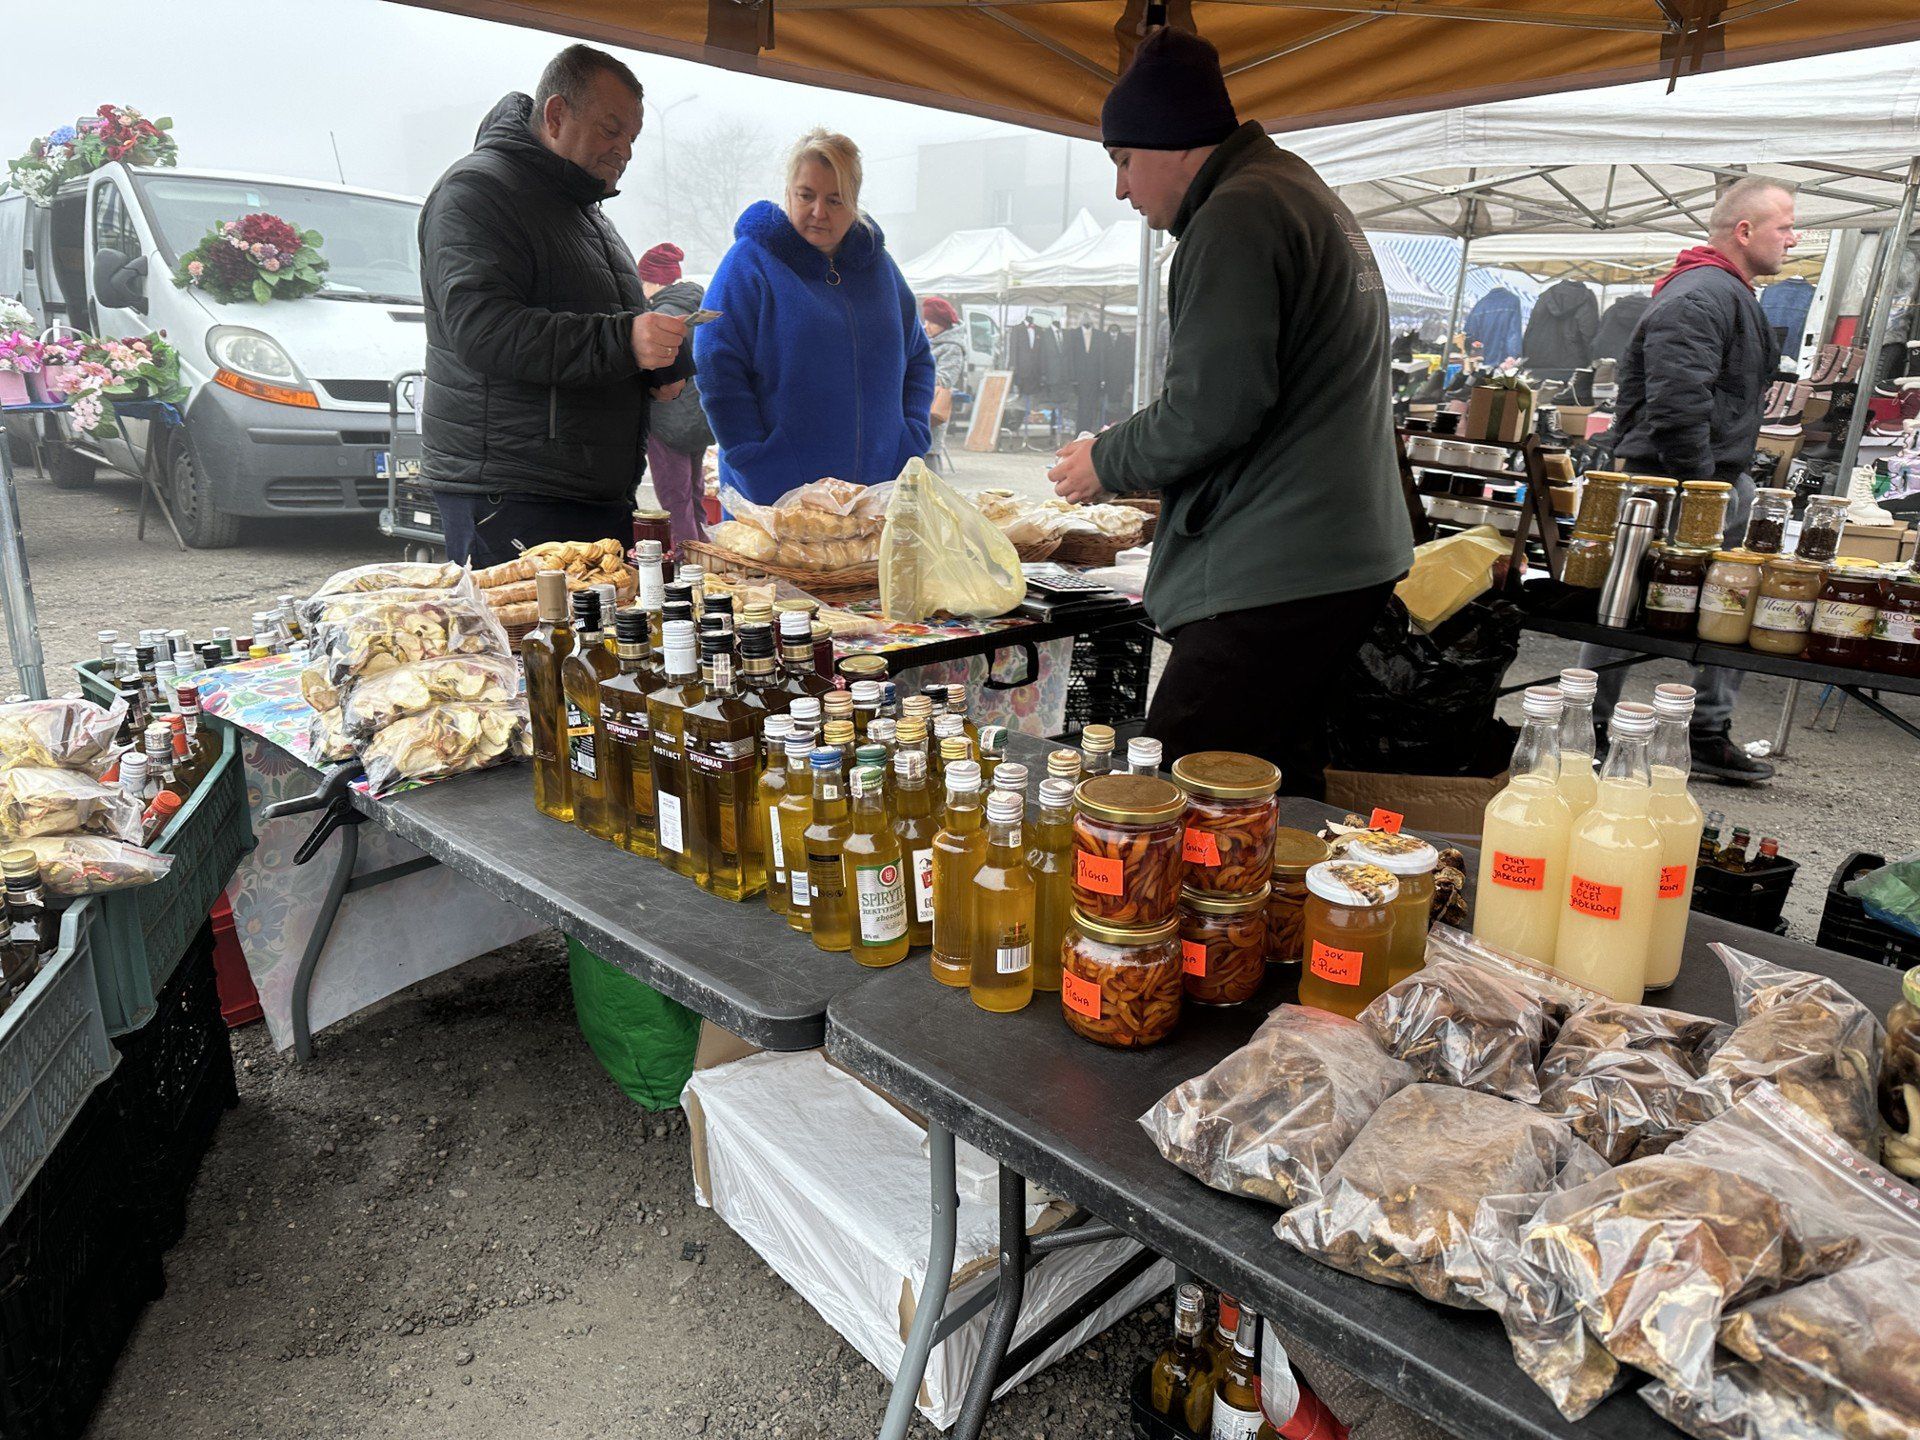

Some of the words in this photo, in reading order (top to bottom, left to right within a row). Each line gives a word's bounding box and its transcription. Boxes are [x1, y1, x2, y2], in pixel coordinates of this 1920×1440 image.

[606, 724, 639, 738] STUMBRAS
[653, 746, 682, 761] DISTINCT
[690, 754, 723, 769] STUMBRAS
[1324, 950, 1345, 961] SOK
